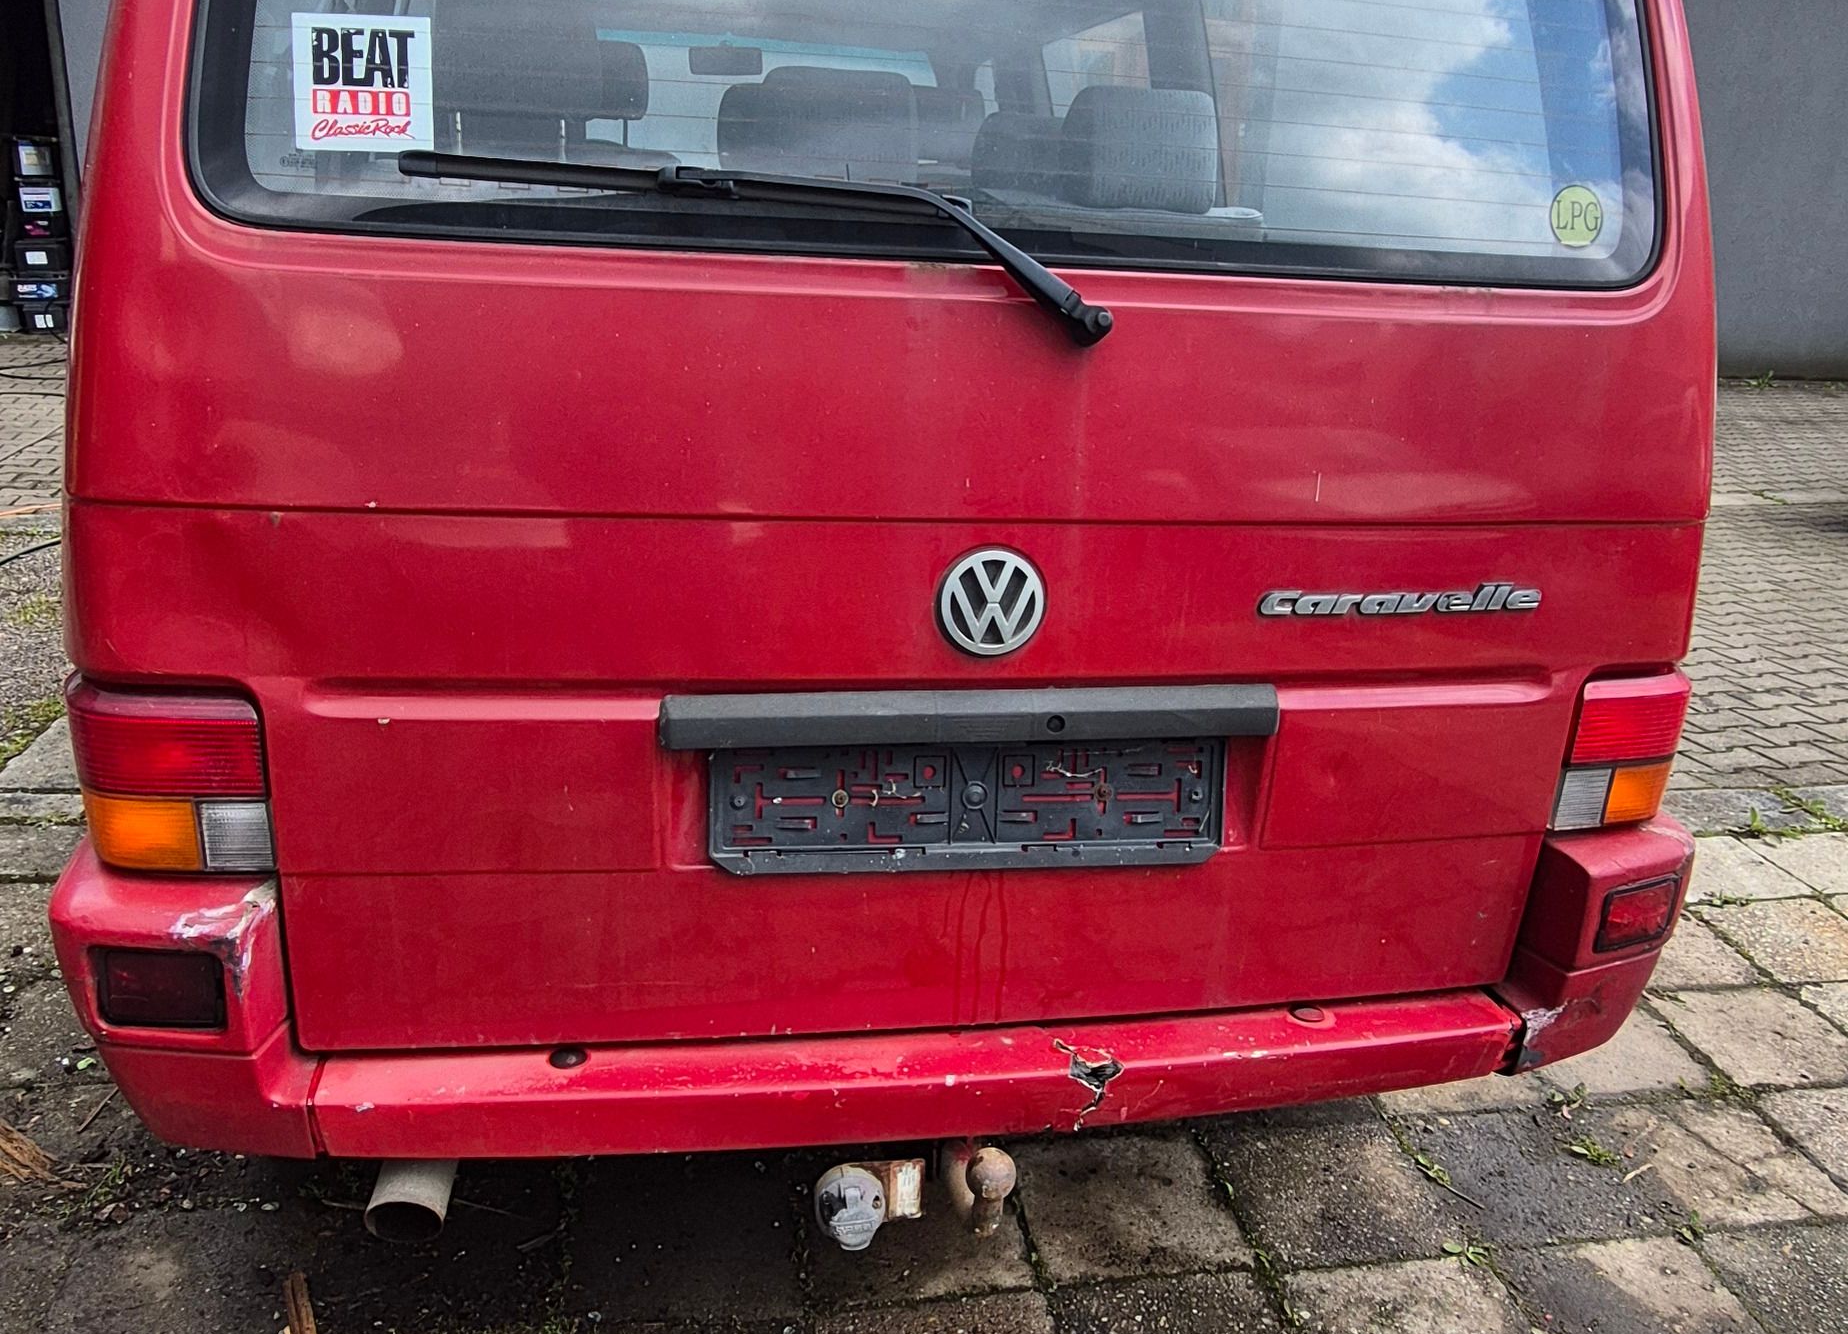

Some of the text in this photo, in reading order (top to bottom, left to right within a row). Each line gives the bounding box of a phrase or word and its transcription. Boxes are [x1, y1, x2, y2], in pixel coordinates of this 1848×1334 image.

[311, 26, 415, 89] BEAT
[316, 90, 407, 116] RADIO
[1555, 199, 1600, 232] LPG
[942, 549, 1045, 656] VW
[1260, 581, 1542, 616] Caravelle
